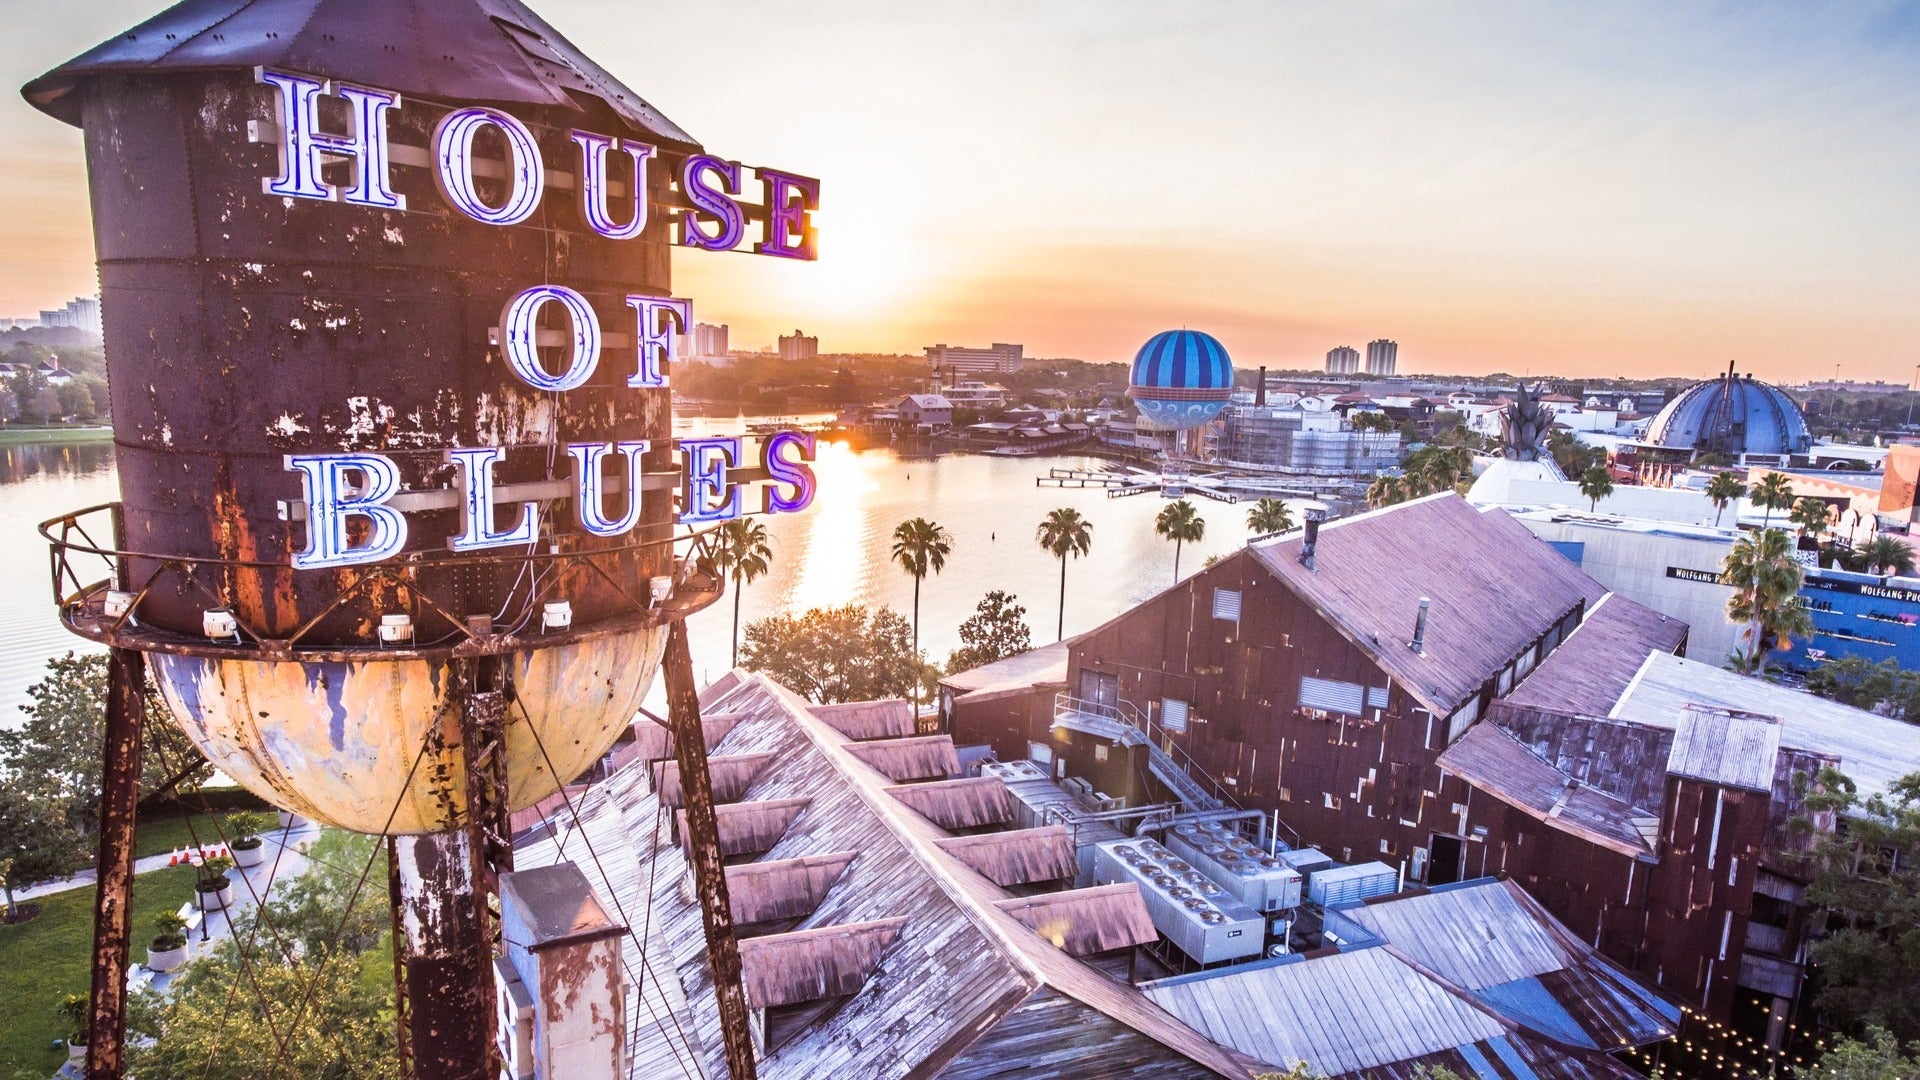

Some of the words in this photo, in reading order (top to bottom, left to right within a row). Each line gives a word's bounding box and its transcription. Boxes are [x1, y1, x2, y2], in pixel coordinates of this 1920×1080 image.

[254, 65, 820, 261] HOUSE
[501, 284, 693, 392] OF
[284, 431, 817, 570] BLUES
[1676, 568, 1712, 582] WOLFGANG
[1860, 584, 1903, 600] WOLFGANG
